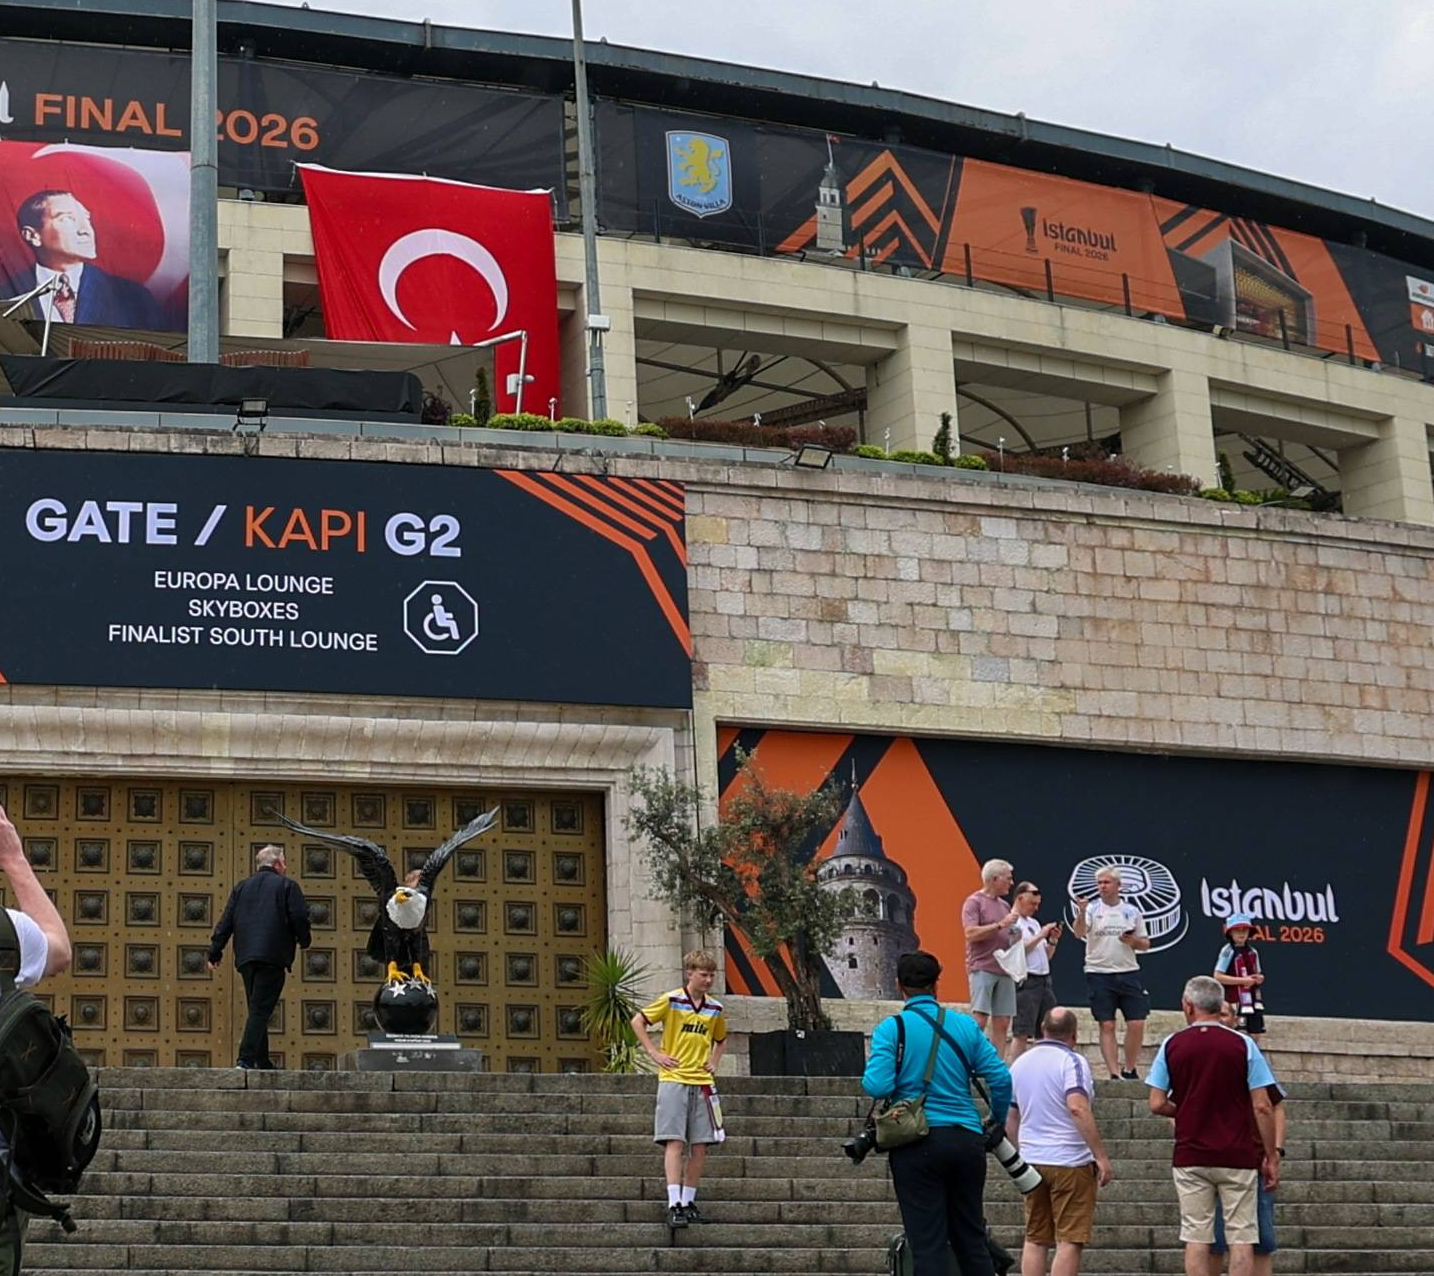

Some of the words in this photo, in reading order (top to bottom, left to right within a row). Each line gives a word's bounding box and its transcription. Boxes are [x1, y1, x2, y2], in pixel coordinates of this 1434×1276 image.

[34, 92, 183, 137] FINAL
[214, 109, 320, 151] 026
[1042, 217, 1118, 253] Istanbul
[1054, 242, 1083, 257] FINAL
[1084, 248, 1110, 262] 2026
[25, 498, 178, 546] GATE
[193, 504, 228, 546] /
[243, 504, 366, 553] KAPI
[384, 512, 462, 558] G2
[154, 570, 240, 591] EUROPA
[245, 574, 334, 595] LOUNGE
[188, 599, 300, 620] SKYBOXES
[108, 624, 205, 645] FINALIST
[209, 627, 284, 648] SOUTH
[289, 630, 378, 651] LOUNGE
[1201, 877, 1340, 923] Istanbul
[1280, 926, 1325, 943] 2026
